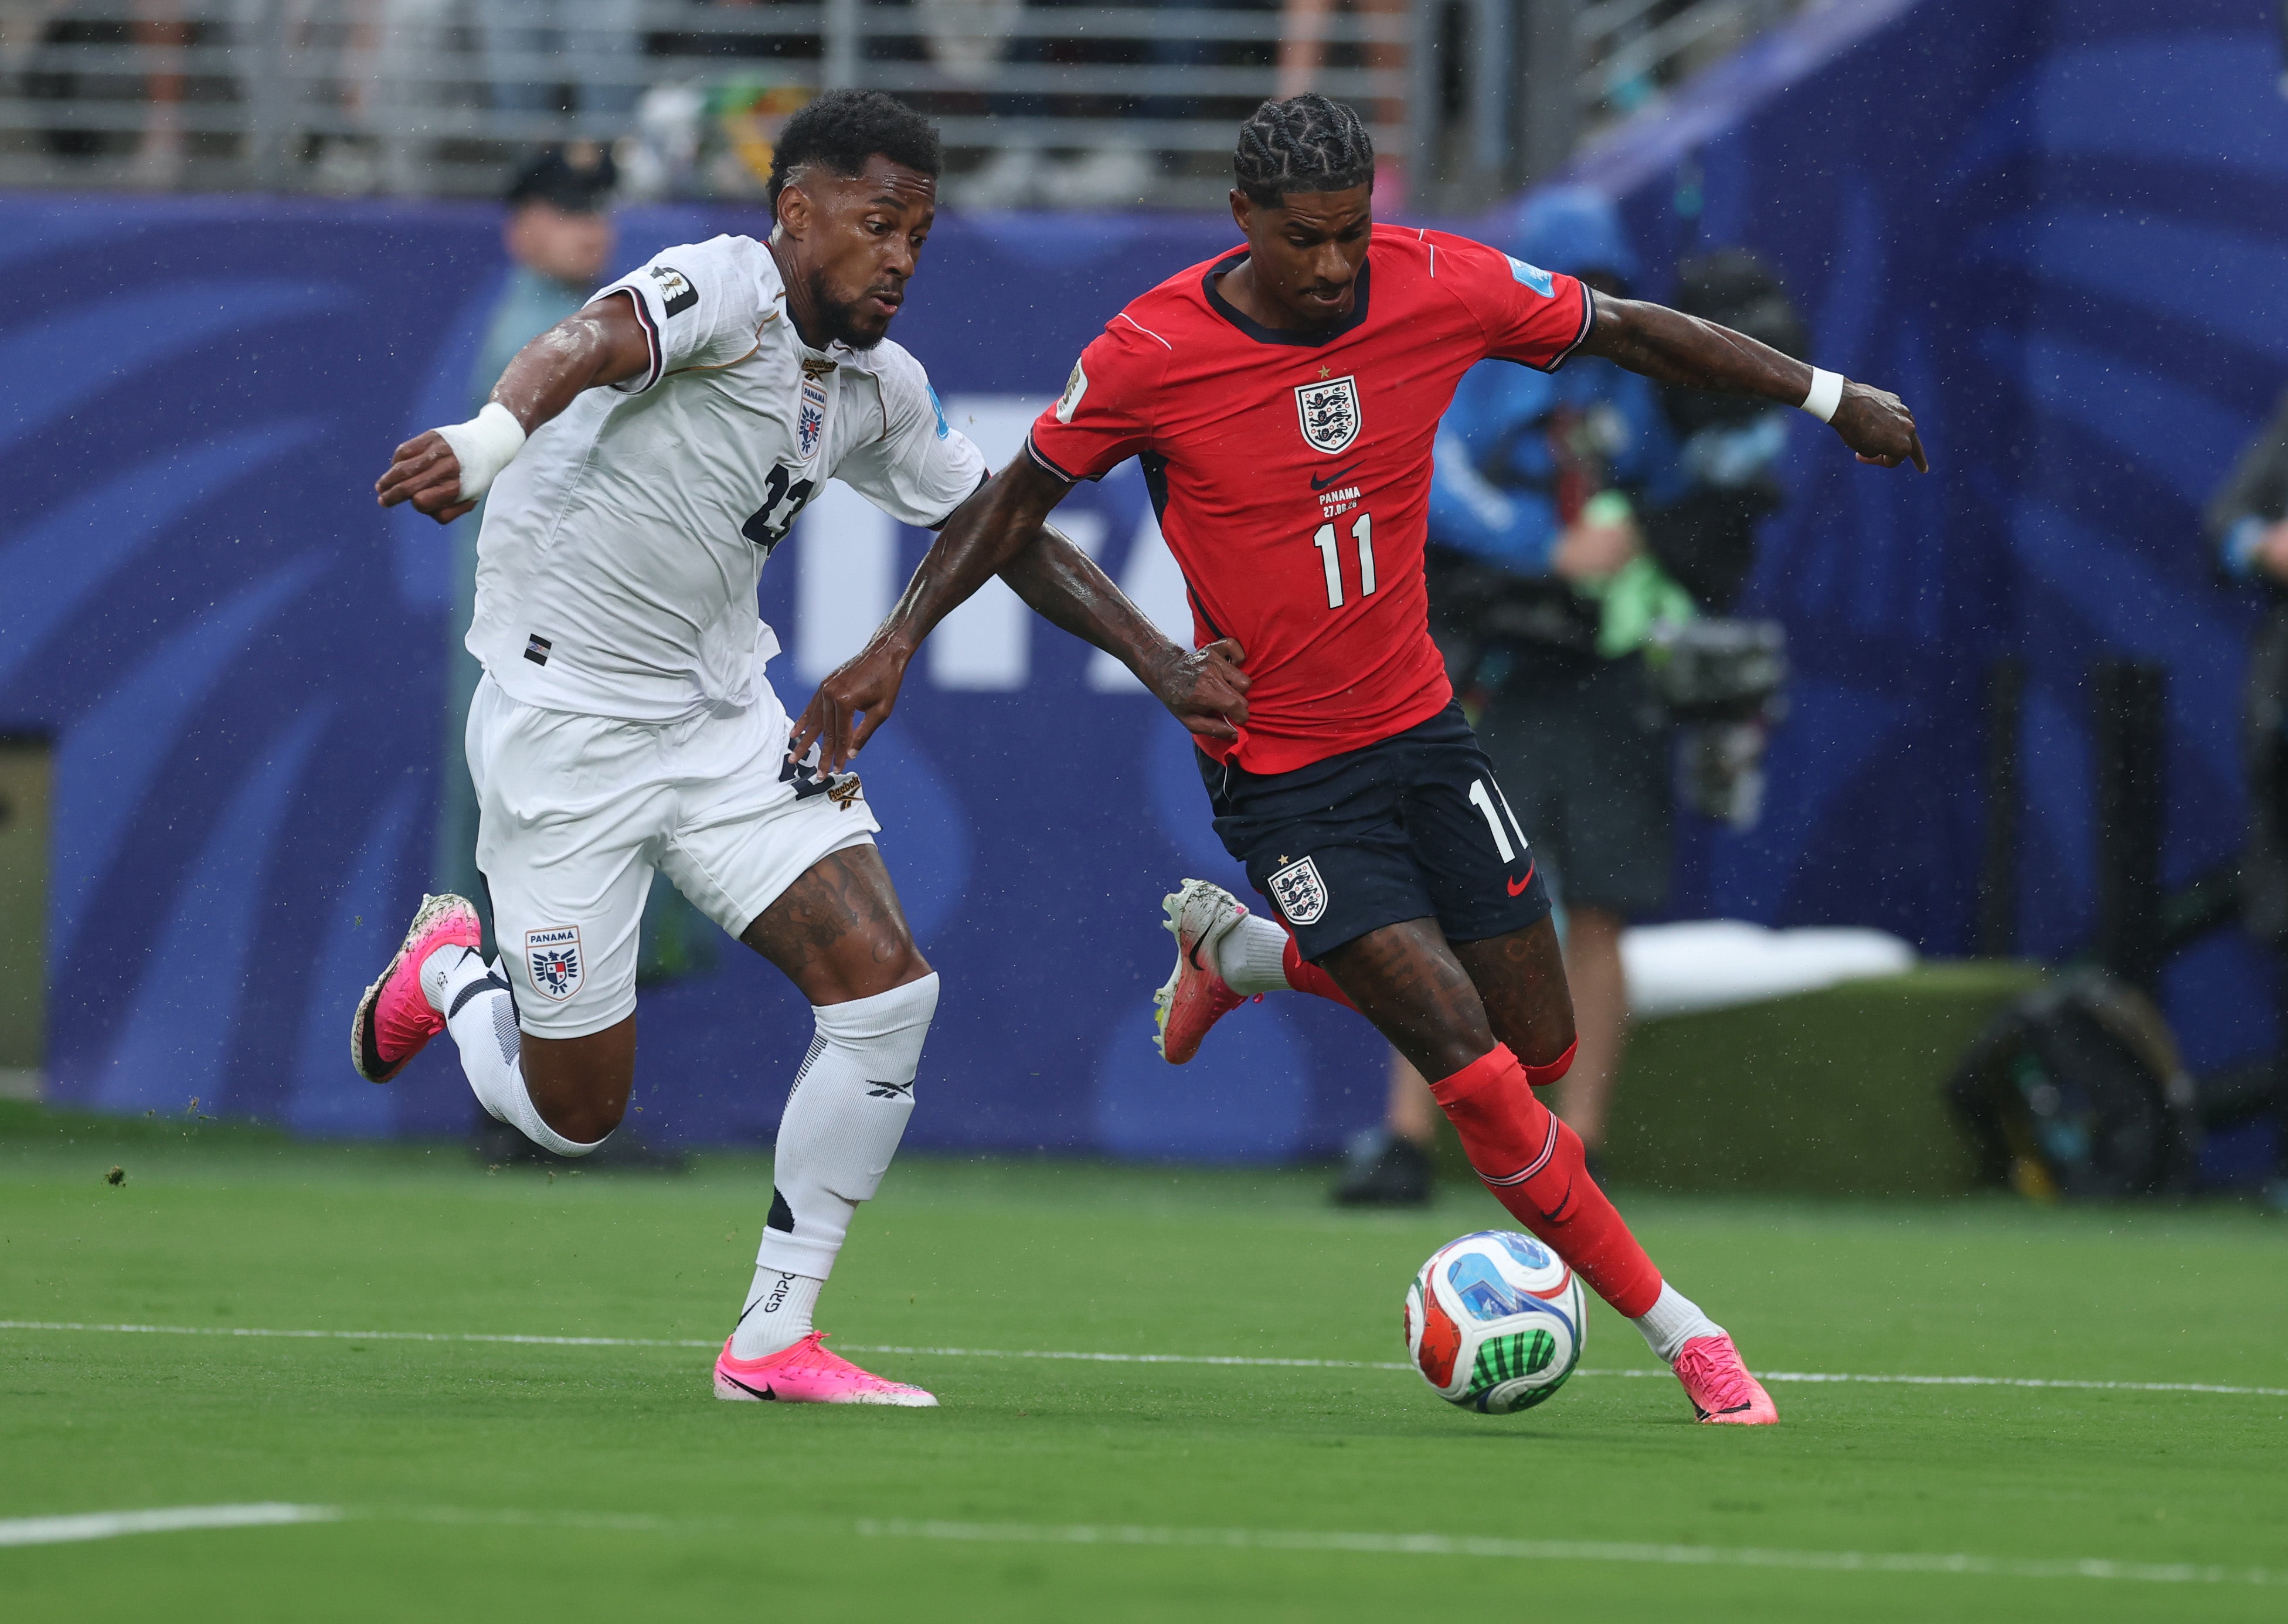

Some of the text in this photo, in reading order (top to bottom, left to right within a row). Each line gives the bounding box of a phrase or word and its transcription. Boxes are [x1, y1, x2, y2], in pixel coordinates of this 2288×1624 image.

[1319, 486, 1361, 505] PANAMA
[1323, 500, 1357, 518] 27.06.26
[1313, 512, 1376, 609] 11
[827, 776, 861, 801] Reebok
[531, 930, 574, 943] PANAMÁ
